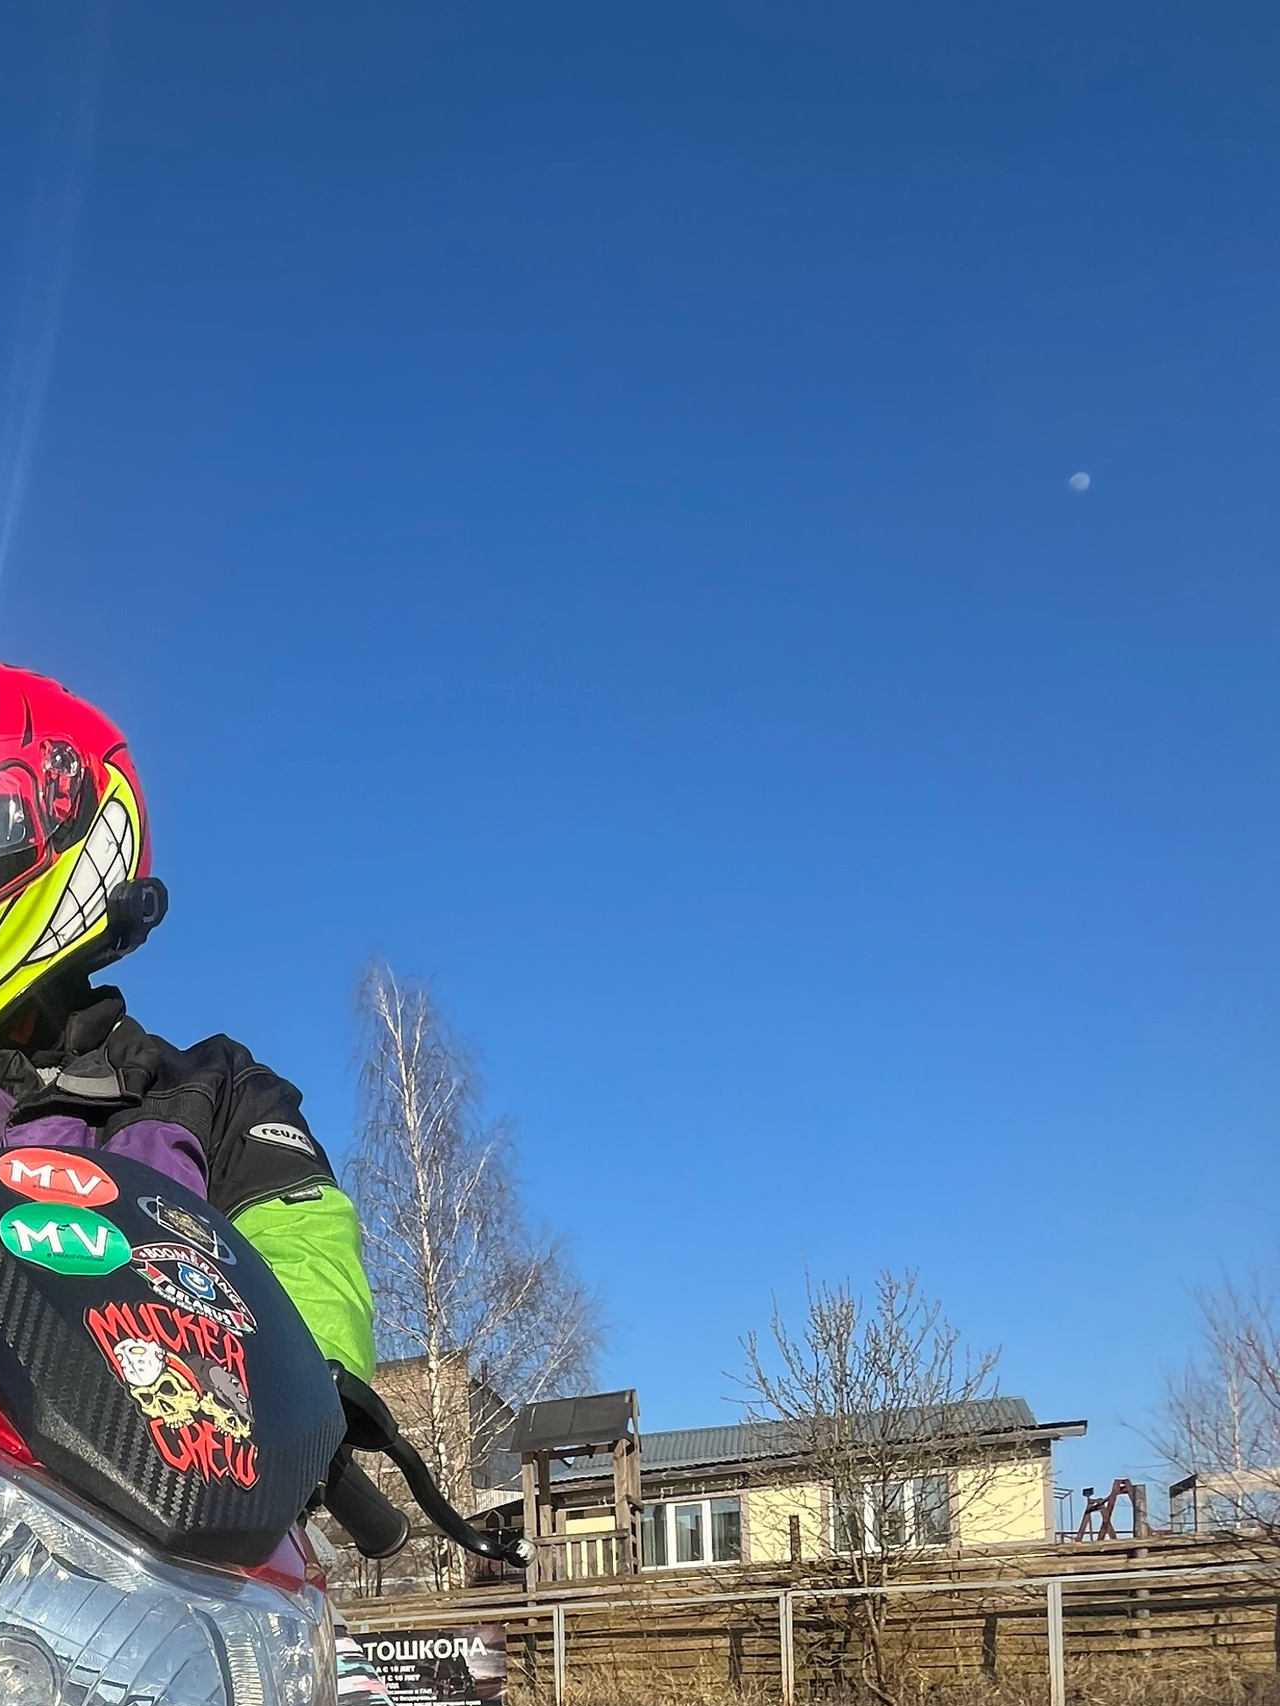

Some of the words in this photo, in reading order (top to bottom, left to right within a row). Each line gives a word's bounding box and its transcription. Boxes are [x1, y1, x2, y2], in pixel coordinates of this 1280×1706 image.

[165, 1285, 232, 1326] BELARUS
[88, 1302, 251, 1399] MUCKER
[362, 1636, 488, 1662] ТОШКОЛА
